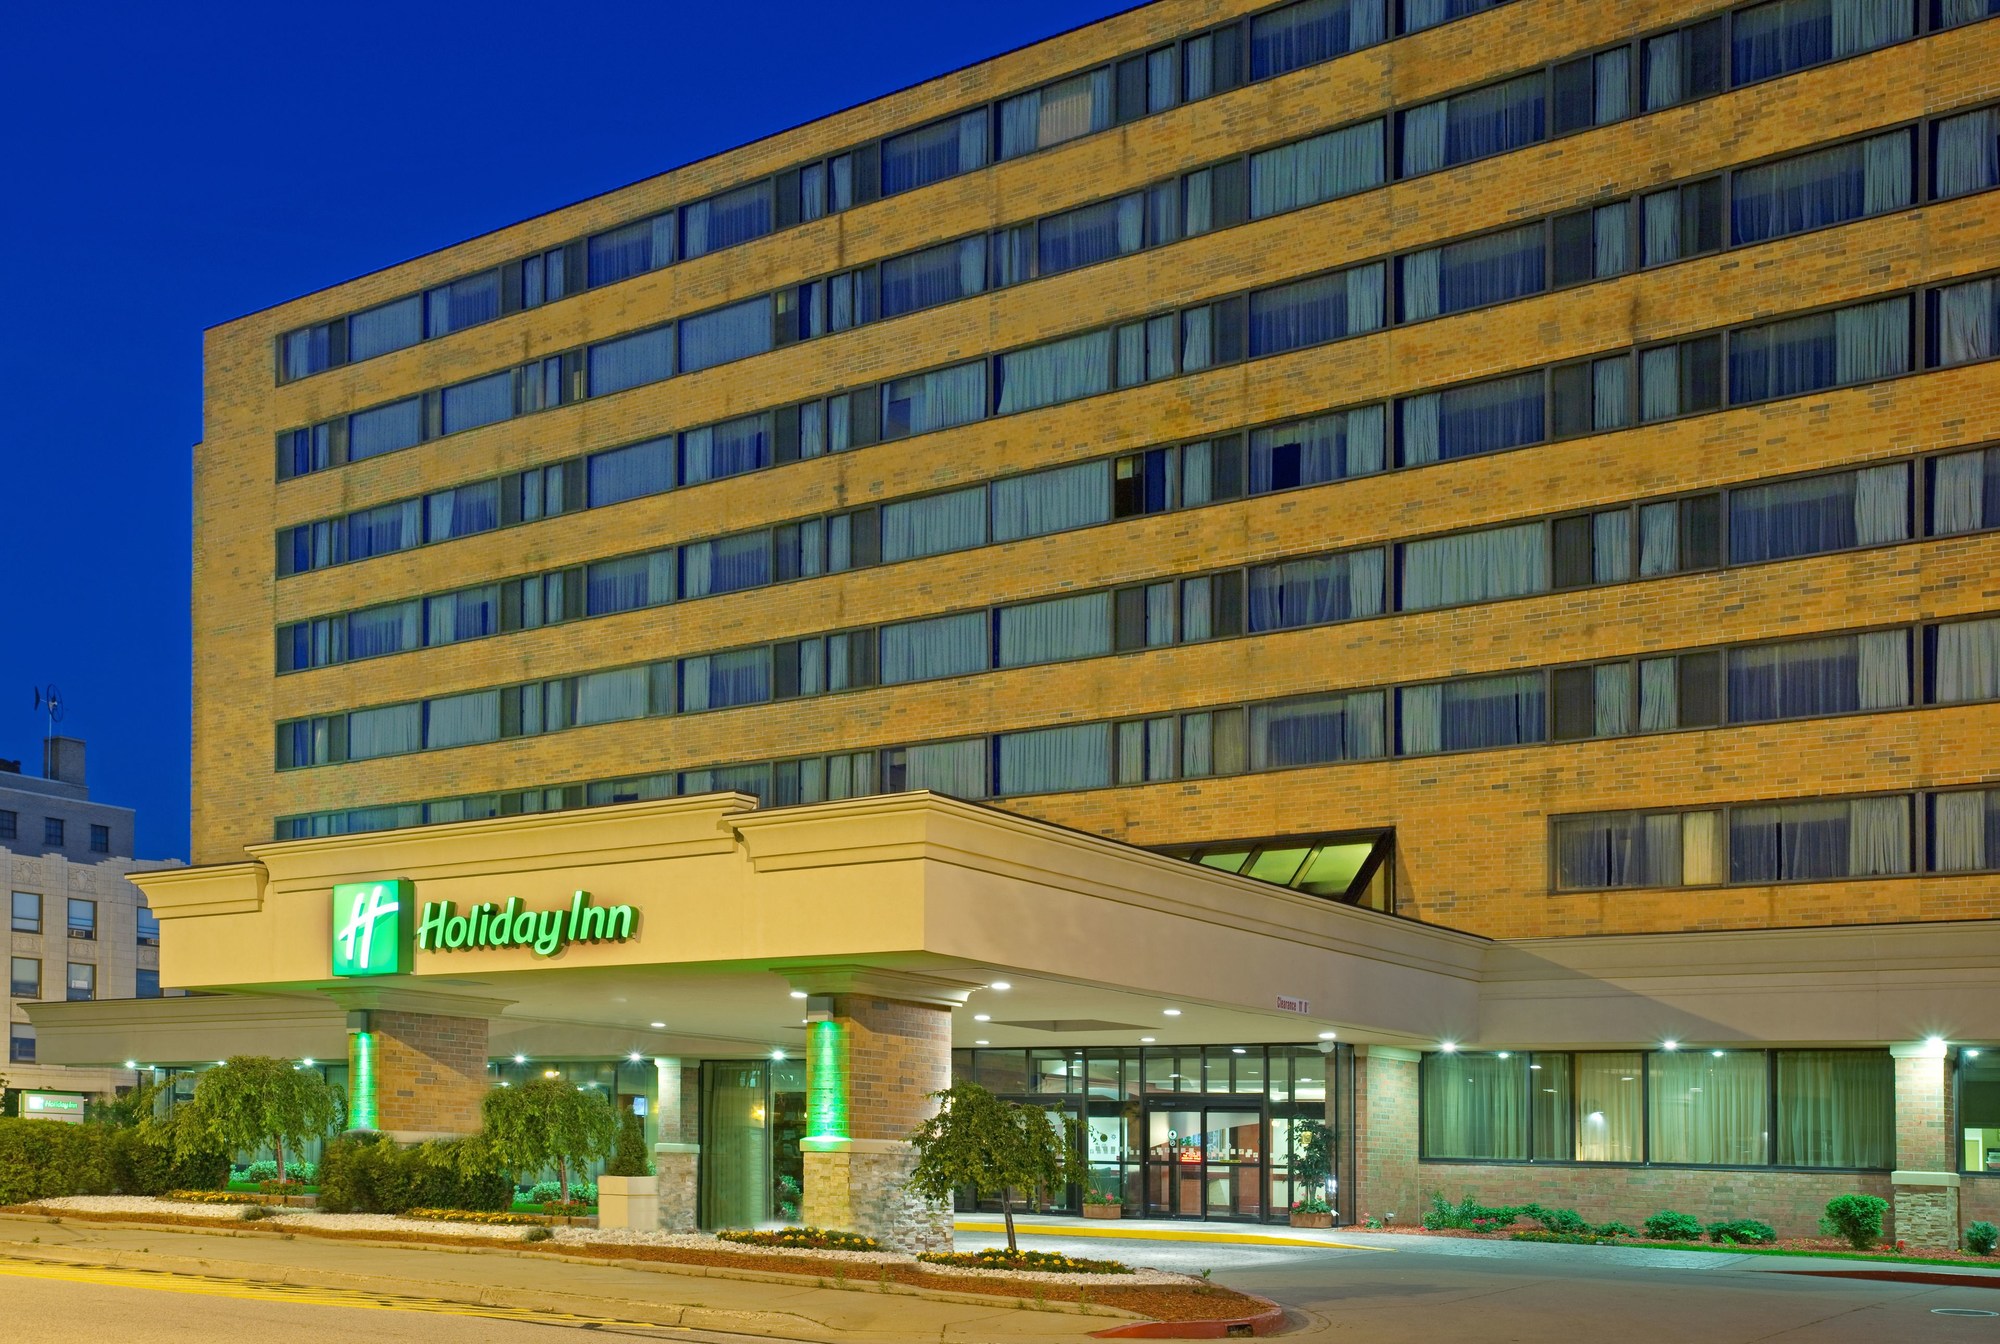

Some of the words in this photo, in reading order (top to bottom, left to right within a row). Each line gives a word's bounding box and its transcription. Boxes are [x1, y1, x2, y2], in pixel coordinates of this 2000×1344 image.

[417, 896, 564, 955] Holiday
[568, 889, 633, 941] Inn
[44, 1101, 69, 1110] Holiday
